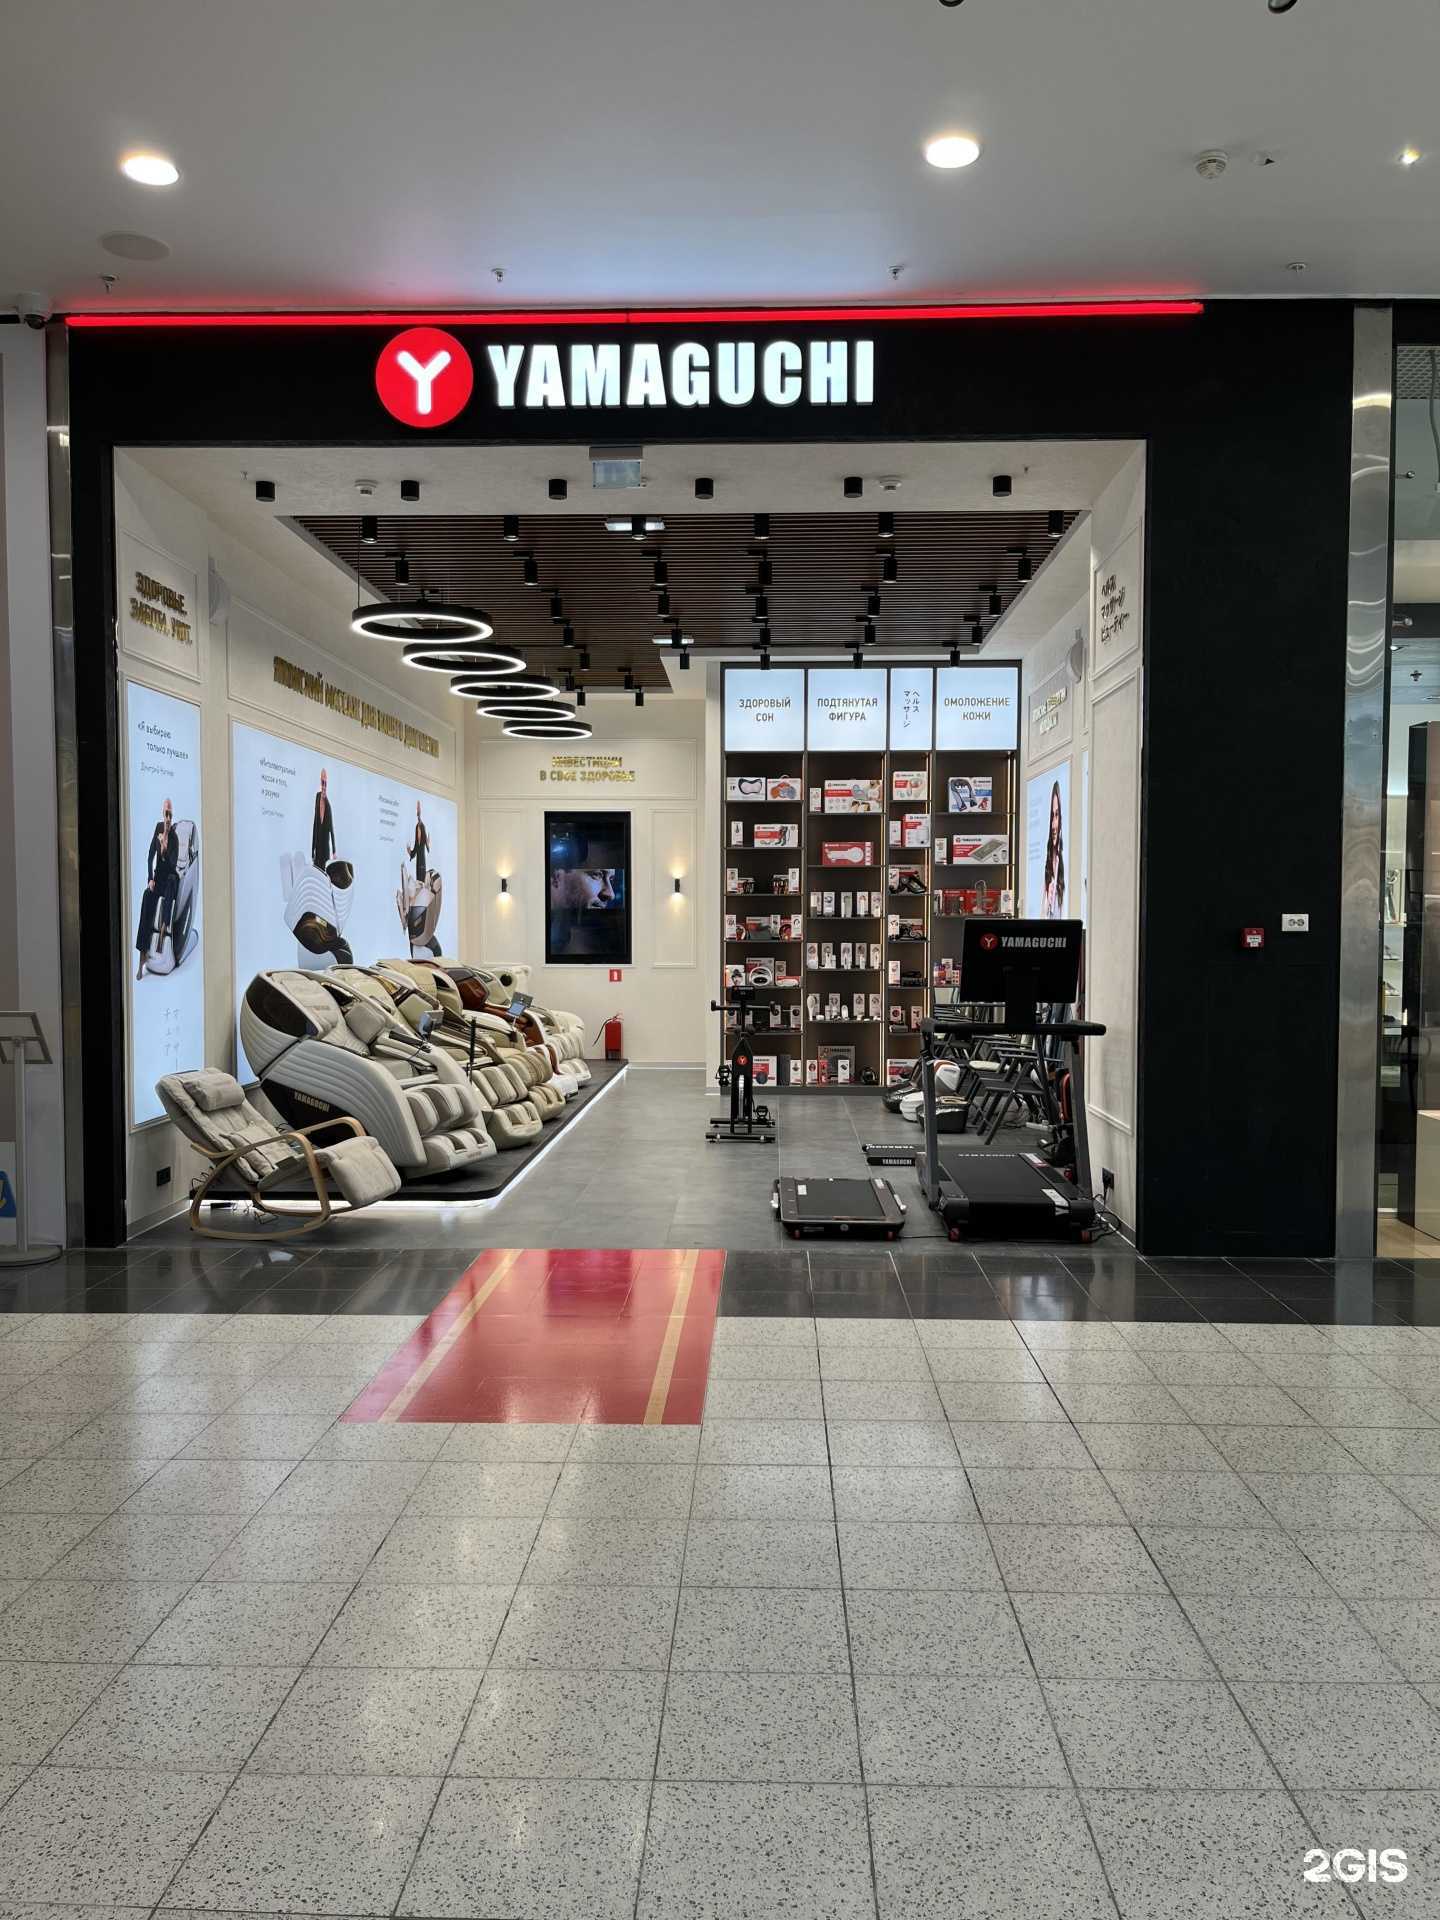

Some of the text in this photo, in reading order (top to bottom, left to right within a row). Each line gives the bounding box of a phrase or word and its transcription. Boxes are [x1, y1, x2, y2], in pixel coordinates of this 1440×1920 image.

[396, 340, 875, 415] Y YAMAGUCHI
[739, 697, 791, 709] ЗДОРОВЫЙ
[817, 698, 878, 709] ПОДТЯНУТАЯ
[944, 697, 1010, 707] ОМОЛОЖЕНИЕ
[755, 712, 774, 722] СОН
[828, 712, 866, 721] ФИГУРА
[962, 711, 991, 721] КОЖИ
[539, 770, 636, 782] В СВОЕ ЗДОРОВЬЕ
[1001, 936, 1067, 948] YAMAGUCHI
